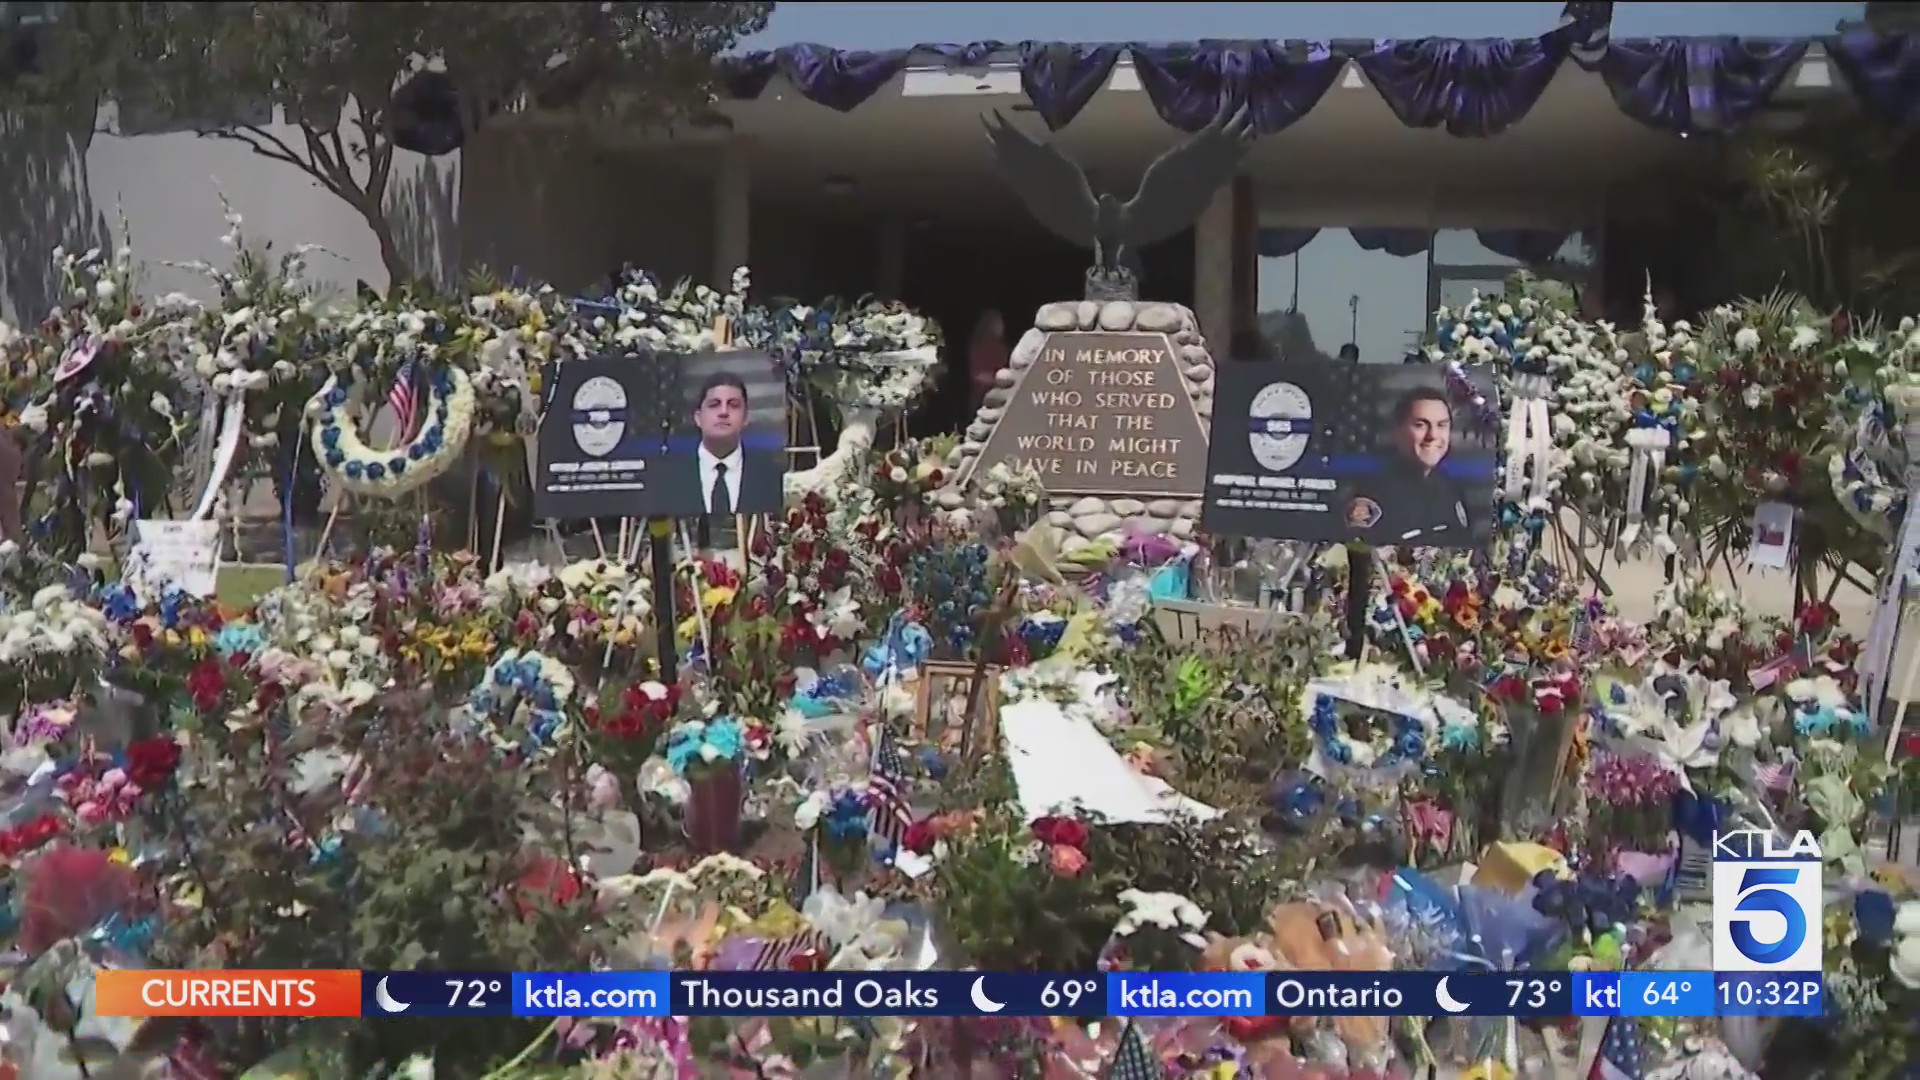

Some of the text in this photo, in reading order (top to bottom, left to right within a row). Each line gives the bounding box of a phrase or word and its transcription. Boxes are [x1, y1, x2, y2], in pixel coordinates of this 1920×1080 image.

[1043, 349, 1165, 364] IN MEMORY
[1046, 368, 1156, 386] OF THOSE
[1031, 391, 1176, 409] WHO SERVED
[1047, 413, 1155, 431] THAT THE
[1017, 435, 1181, 454] WORLD MIGHT
[1076, 460, 1098, 475] IN
[1111, 460, 1179, 478] PEACE
